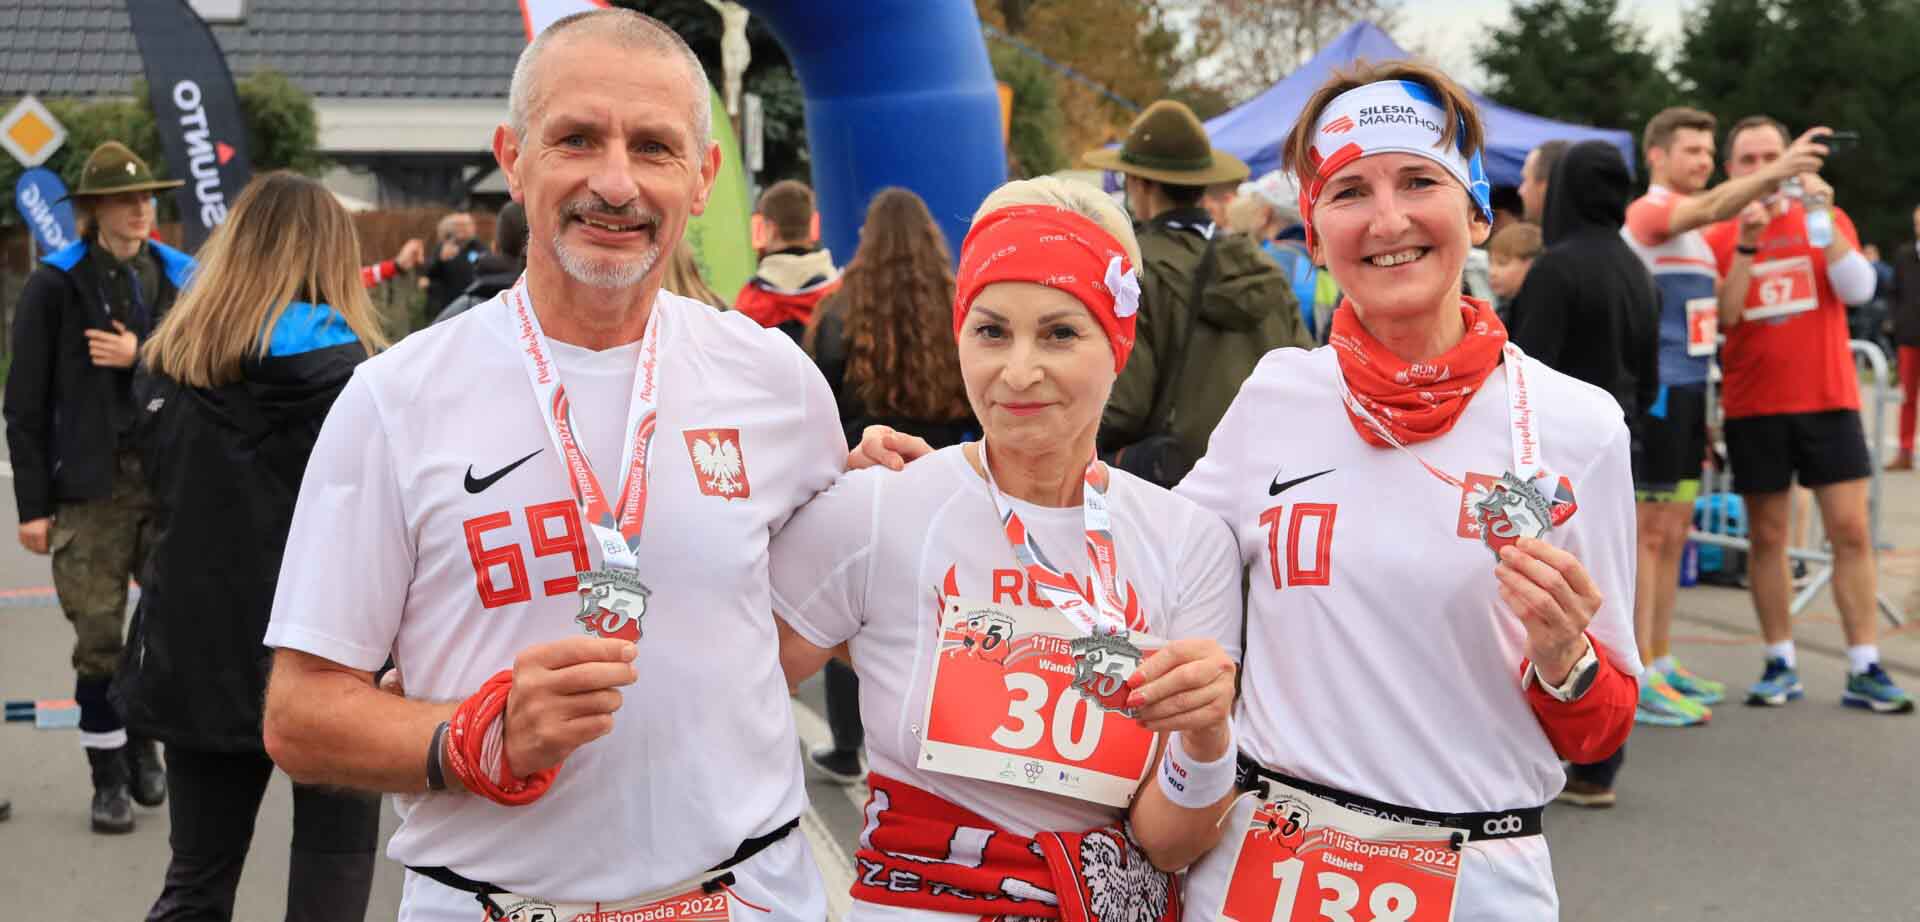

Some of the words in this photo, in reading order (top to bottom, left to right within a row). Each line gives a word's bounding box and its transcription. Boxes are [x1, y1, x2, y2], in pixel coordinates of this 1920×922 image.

[1359, 104, 1416, 117] SILESIA
[1359, 113, 1445, 137] MARATHON
[1759, 277, 1793, 306] 67
[1410, 363, 1438, 375] RUN
[463, 498, 592, 609] 69
[1258, 503, 1338, 591] 10
[1031, 635, 1046, 651] 11
[991, 672, 1104, 762] 30
[1335, 831, 1409, 860] listopada
[1413, 847, 1457, 867] 2022
[598, 904, 675, 922] istopada
[679, 895, 726, 916] 2022
